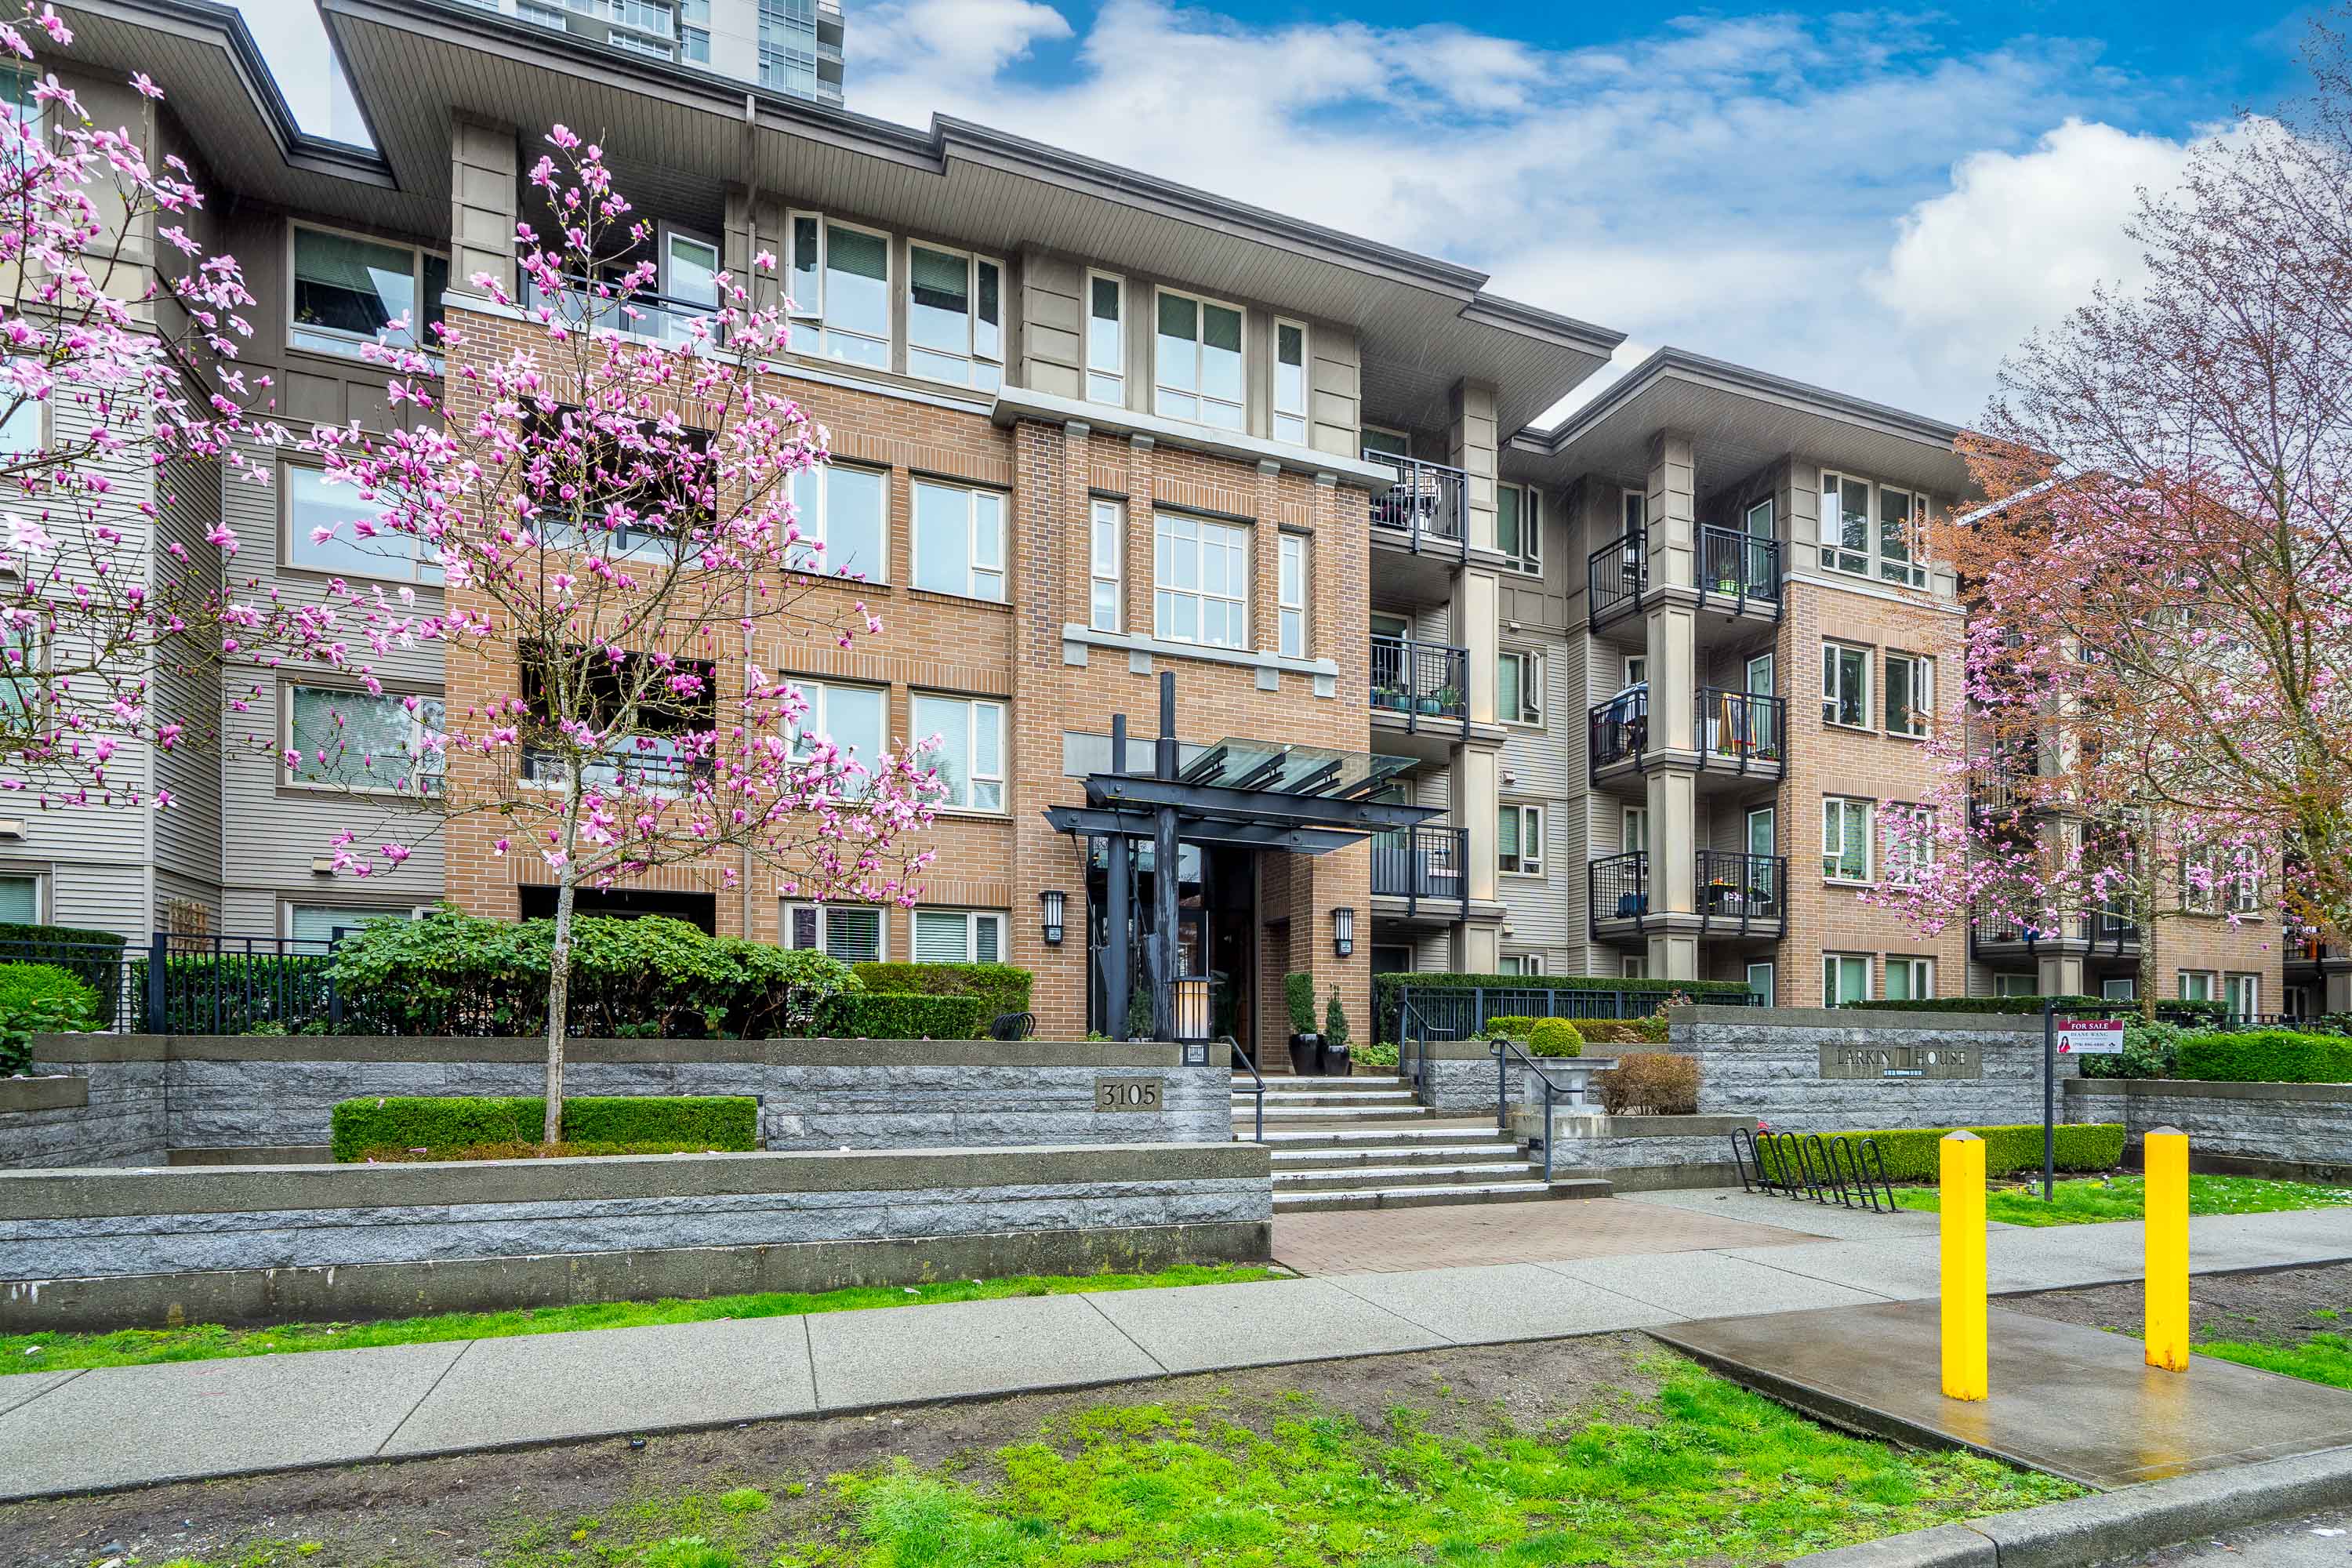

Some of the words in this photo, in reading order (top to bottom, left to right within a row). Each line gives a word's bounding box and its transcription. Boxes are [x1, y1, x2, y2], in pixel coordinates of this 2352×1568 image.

[1837, 1050, 1891, 1065] LARKIN
[1915, 1050, 1965, 1065] HOUSE
[1102, 1084, 1156, 1105] 3105
